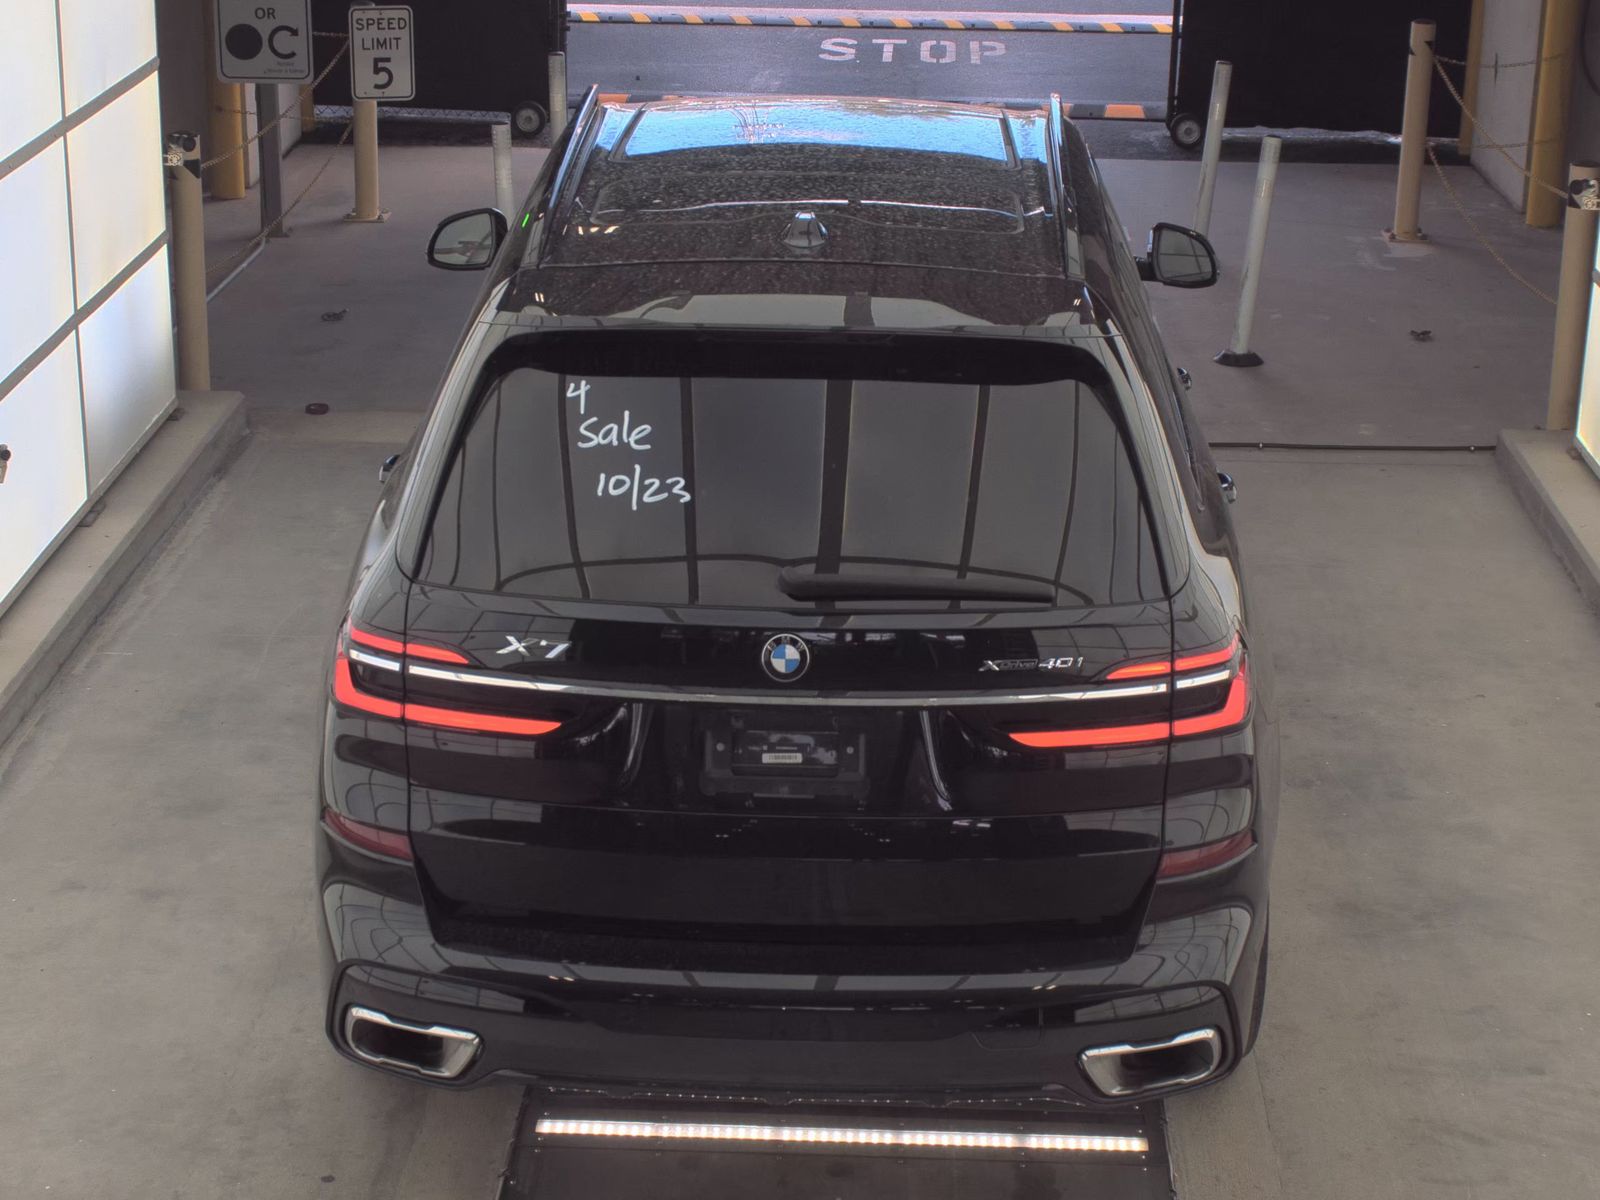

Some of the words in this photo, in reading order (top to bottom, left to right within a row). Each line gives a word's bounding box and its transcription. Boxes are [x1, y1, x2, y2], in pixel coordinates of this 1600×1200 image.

[254, 7, 276, 20] OR
[355, 17, 407, 31] SPEED
[361, 37, 401, 50] LIMIT
[818, 37, 1006, 64] STOP
[373, 57, 393, 89] 5
[566, 380, 591, 415] 4
[597, 464, 691, 511] 10/23
[496, 635, 572, 659] X7
